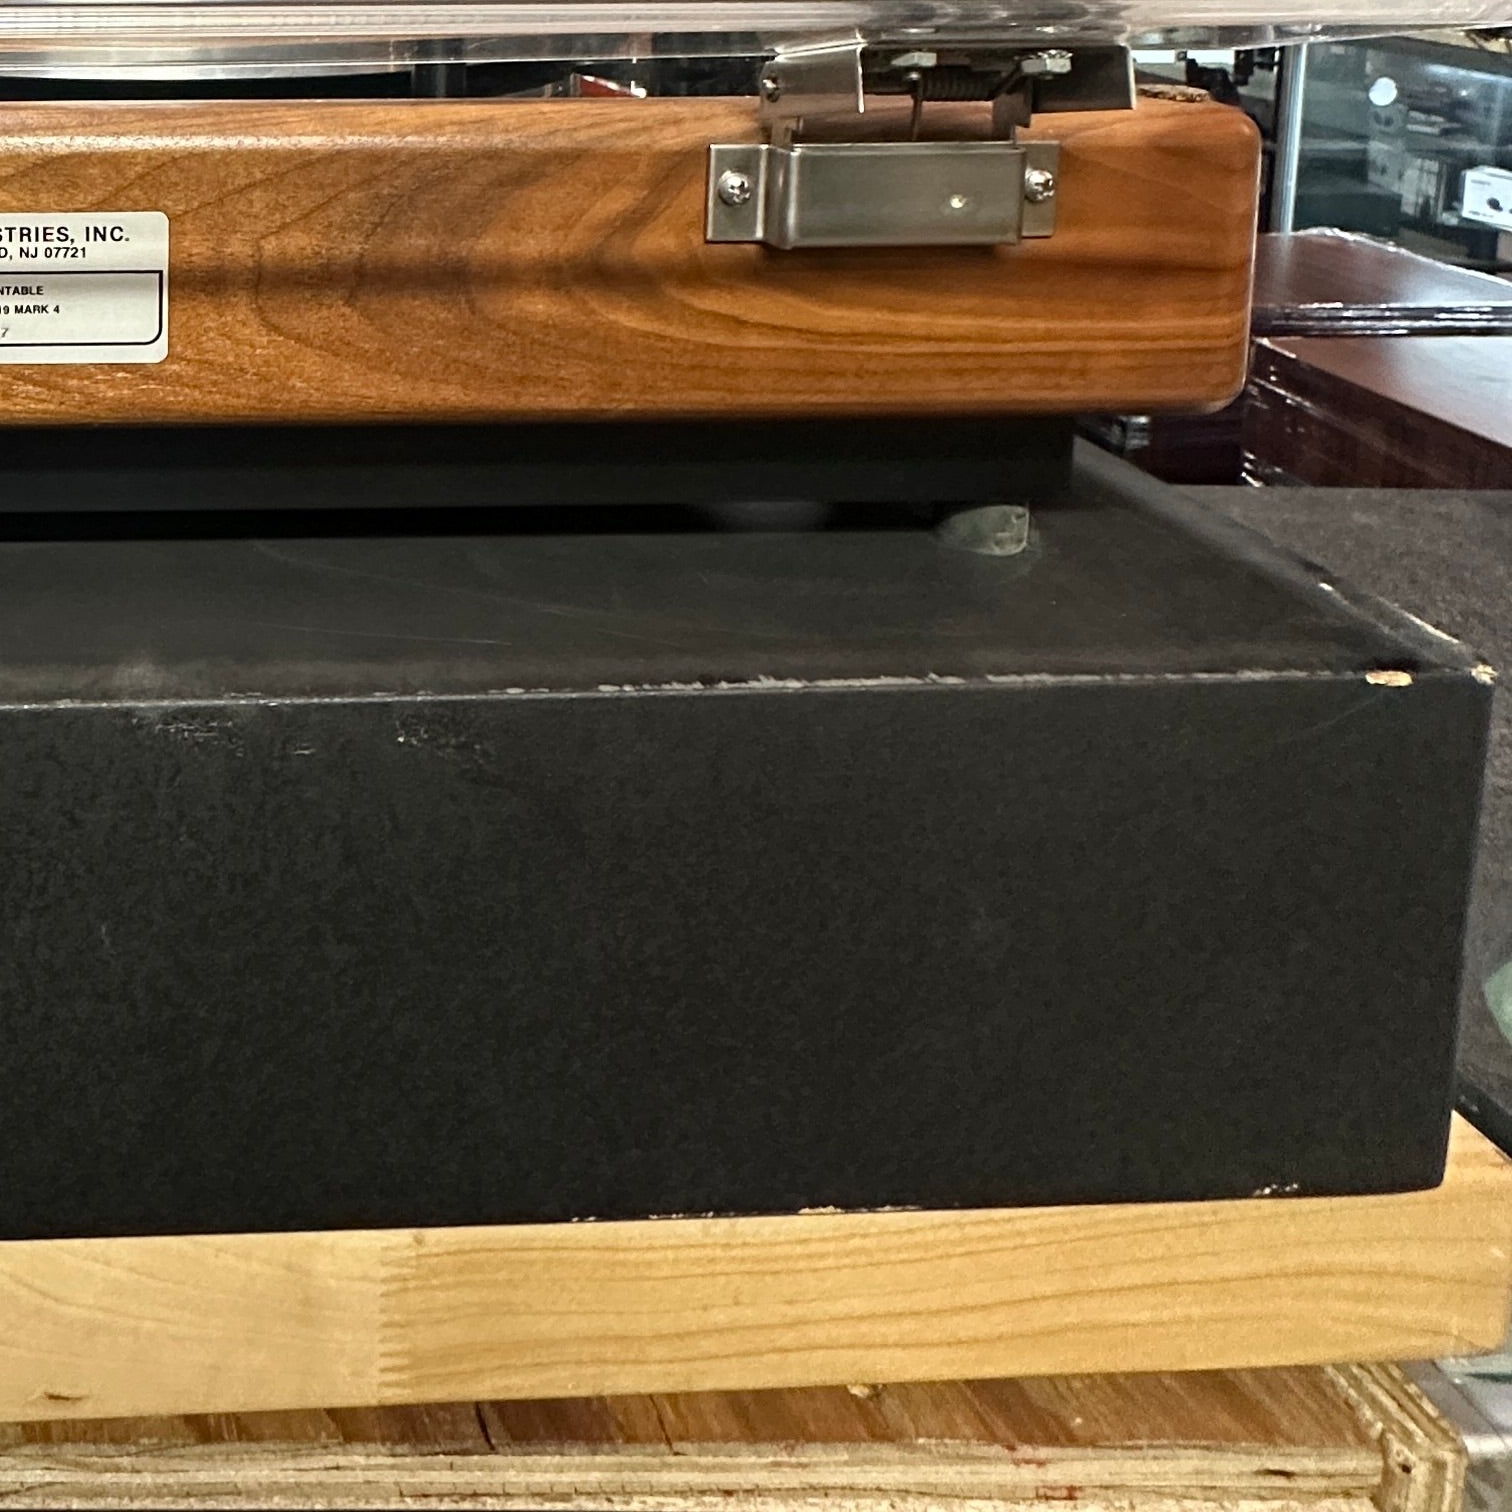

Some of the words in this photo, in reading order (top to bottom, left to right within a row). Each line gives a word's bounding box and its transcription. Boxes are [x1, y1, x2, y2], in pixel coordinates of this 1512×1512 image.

[85, 225, 131, 243] INC.
[19, 246, 39, 259] NJ
[44, 246, 87, 259] 07721
[14, 304, 50, 315] MARK
[52, 304, 61, 315] 4
